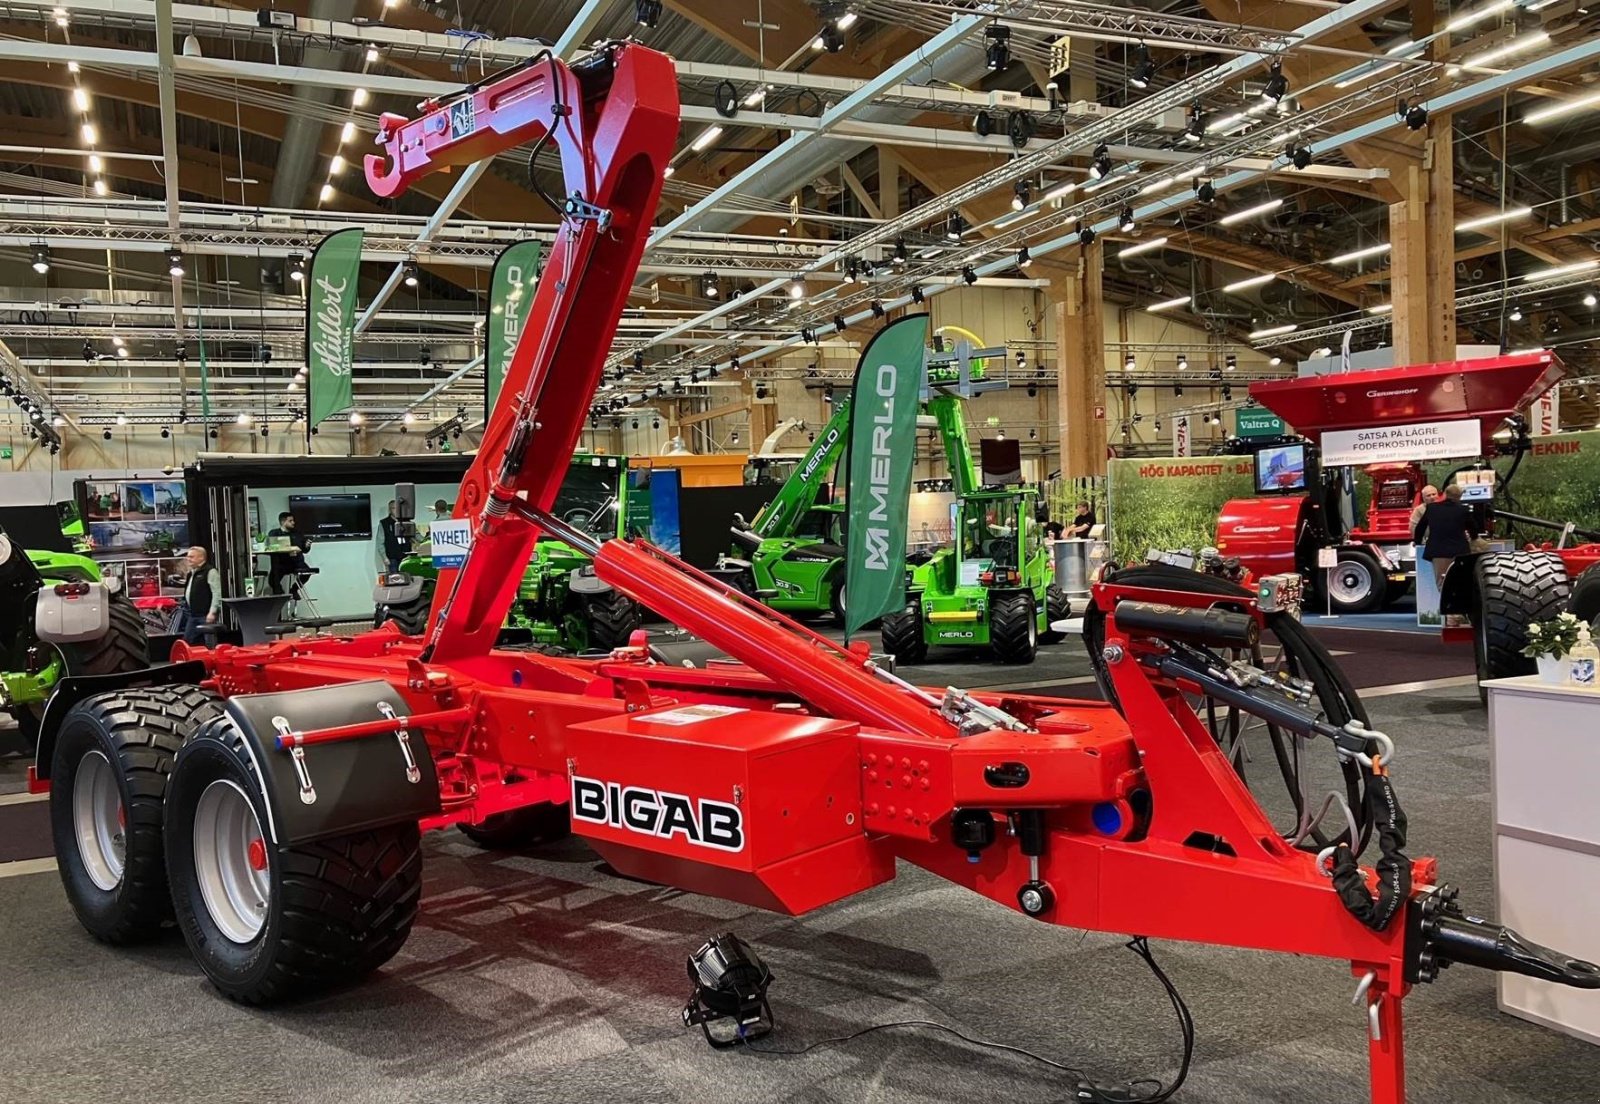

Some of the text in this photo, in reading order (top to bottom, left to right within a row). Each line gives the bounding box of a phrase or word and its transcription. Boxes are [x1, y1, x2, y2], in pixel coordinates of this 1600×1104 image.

[504, 266, 522, 357] MERLO
[342, 326, 351, 375] Maskin
[1240, 419, 1280, 430] Valtra Q
[1357, 431, 1388, 441] SATSA
[800, 429, 839, 482] MERLO
[869, 364, 897, 521] MERLO
[1353, 437, 1445, 451] FODERKOSTNADER
[1139, 464, 1165, 478] HÖG
[1167, 464, 1223, 477] KAPACITET
[432, 529, 469, 545] NYHET!
[573, 776, 744, 852] BIGAB
